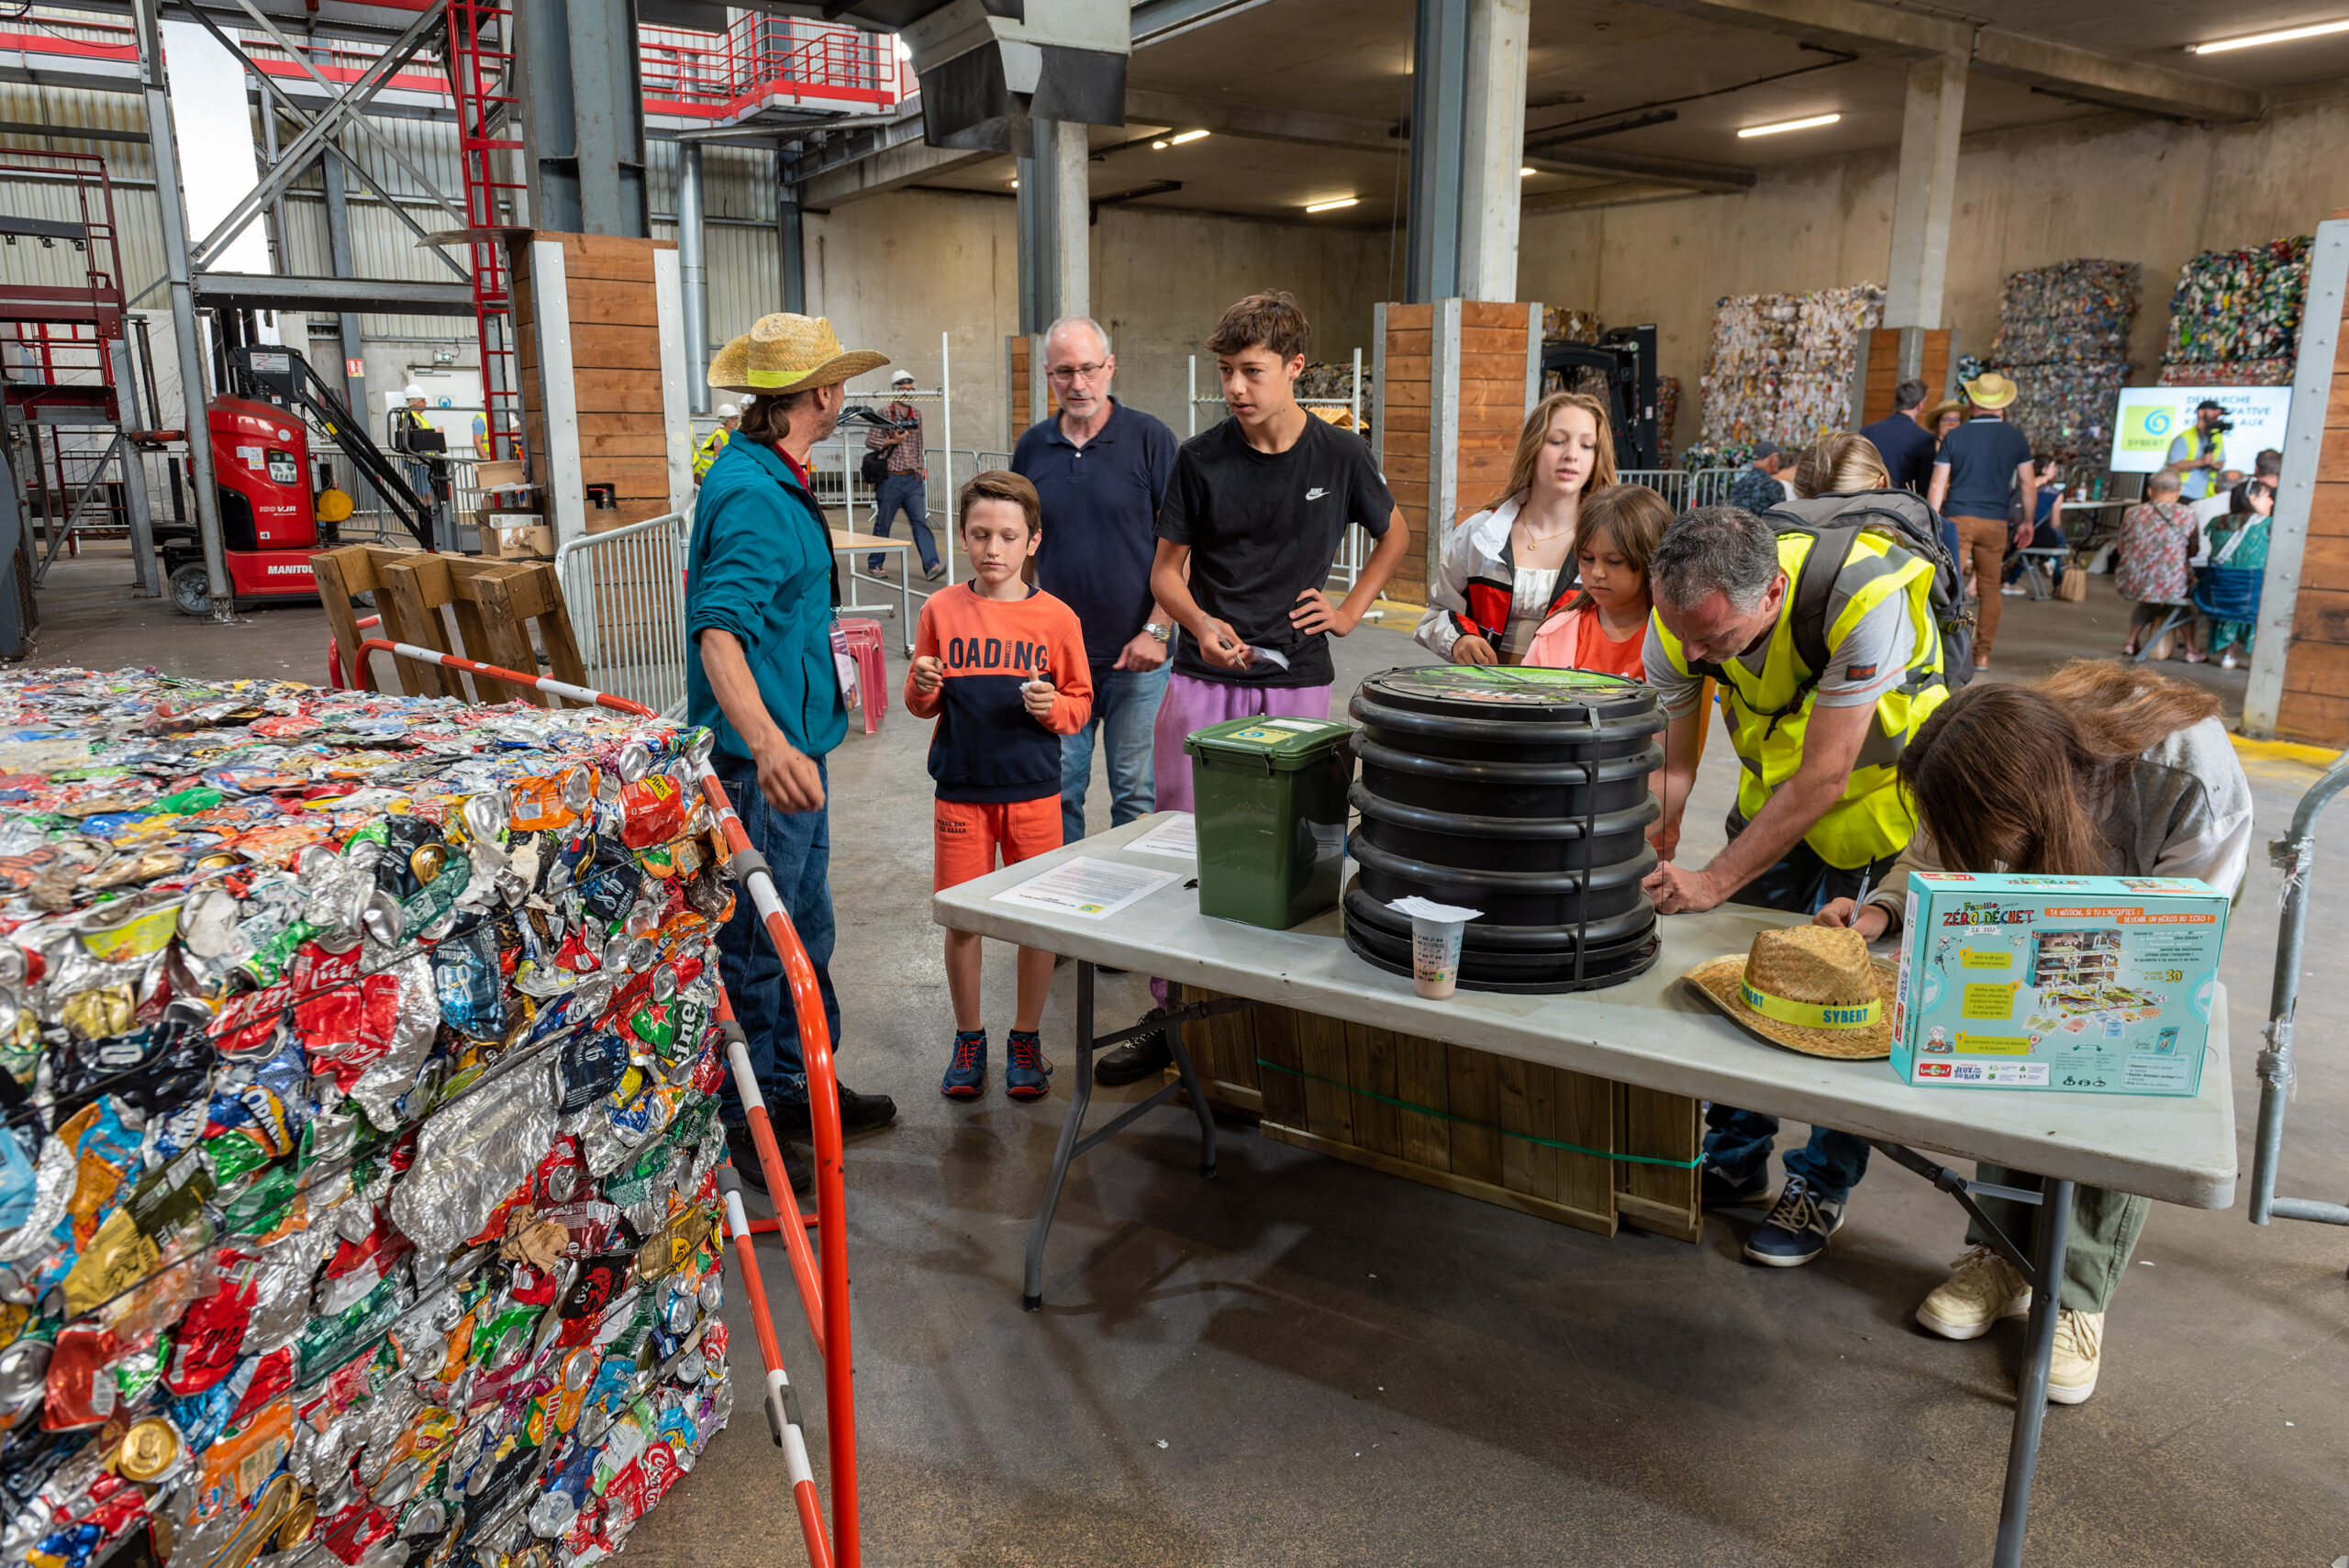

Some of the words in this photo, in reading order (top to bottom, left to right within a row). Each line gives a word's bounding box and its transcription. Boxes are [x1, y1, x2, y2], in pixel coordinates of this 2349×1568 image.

[1308, 488, 1323, 496] NIKE
[1943, 908, 1979, 926] ZÉRO
[1983, 907, 2034, 925] DÉCHET
[2060, 908, 2084, 917] MISSION,
[2102, 908, 2135, 917] L'ACCEPTES
[2158, 915, 2177, 923] HÉROS
[2188, 915, 2206, 923] ZÉRO
[2165, 969, 2183, 983] 3D
[1823, 1008, 1868, 1024] SYBERT
[1954, 1065, 1973, 1073] JEUX
